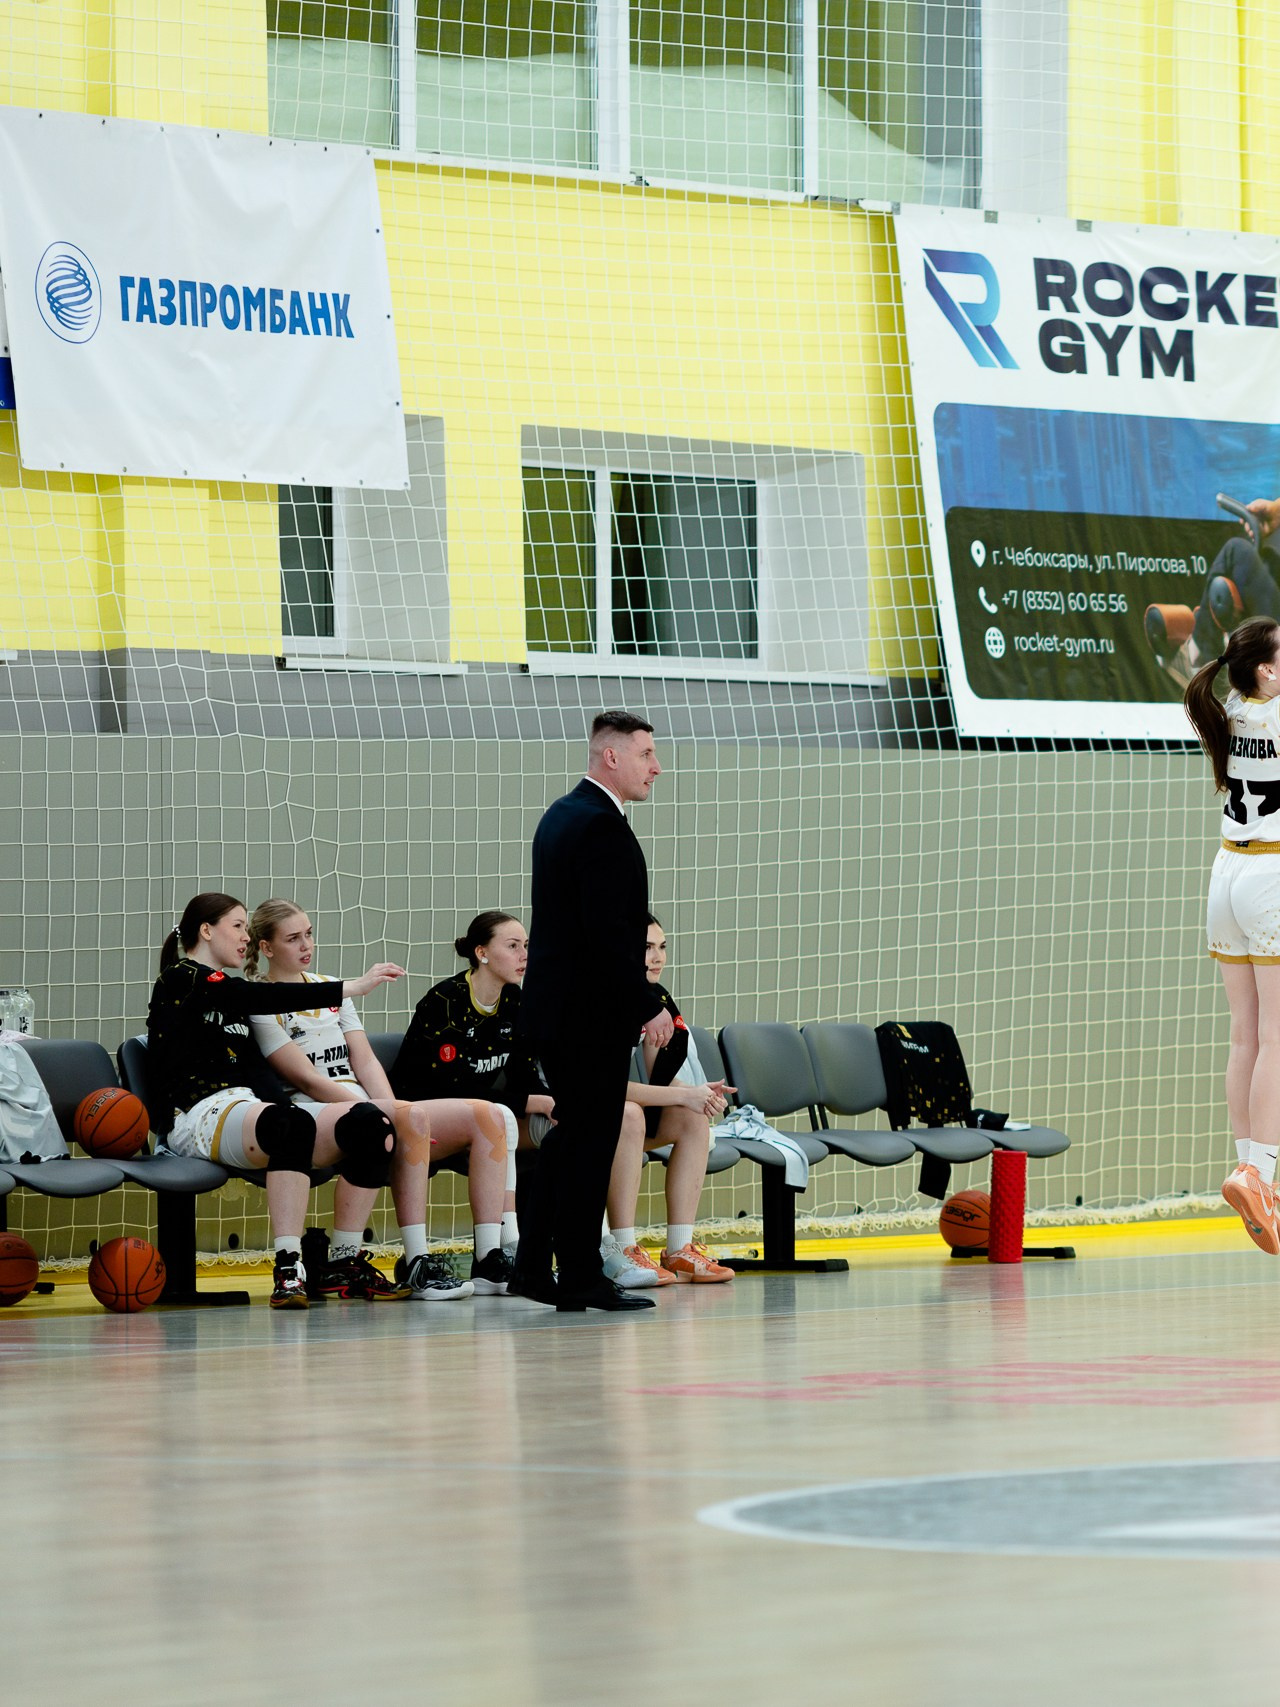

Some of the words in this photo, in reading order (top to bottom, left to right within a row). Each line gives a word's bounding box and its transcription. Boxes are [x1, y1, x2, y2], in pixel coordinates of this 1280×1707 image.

[119, 275, 355, 338] ГАЗПРОМБАНК
[1037, 318, 1195, 382] GYM
[992, 549, 1003, 566] г.
[1004, 547, 1093, 573] Чебоксары,
[1095, 554, 1115, 573] ул.
[1116, 552, 1191, 576] Пирогова,
[1191, 556, 1207, 574] 10
[1001, 590, 1018, 608] +7
[1022, 589, 1065, 614] (8352)
[1068, 592, 1088, 612] 60
[1090, 593, 1107, 612] 65
[1109, 594, 1128, 613] 56
[1014, 632, 1115, 657] rocket-gym.ru
[1229, 734, 1277, 759] АЗКОВА
